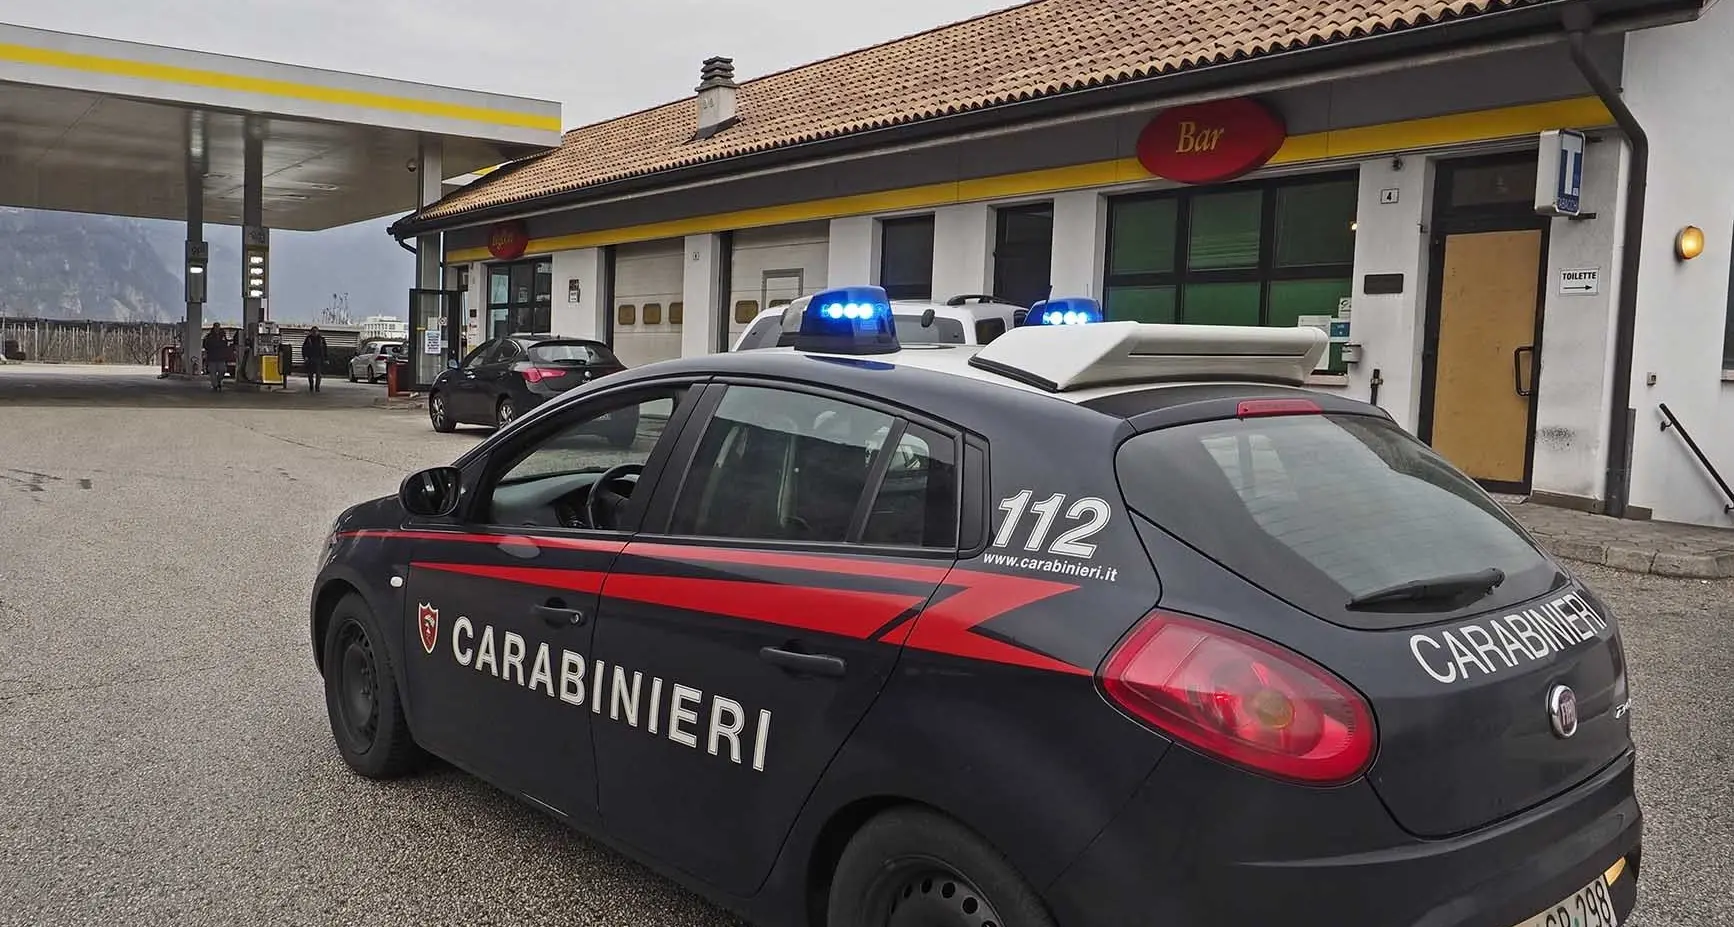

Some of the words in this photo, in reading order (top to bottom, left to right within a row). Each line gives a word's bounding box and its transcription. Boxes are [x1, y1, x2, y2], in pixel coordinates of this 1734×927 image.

[1176, 121, 1225, 152] Bar
[1562, 271, 1597, 280] TOILETTE
[992, 489, 1112, 559] 112
[983, 553, 1118, 582] www.carabinieri.it
[1409, 590, 1607, 684] CARABINIERI
[452, 616, 772, 772] CARABINIERI
